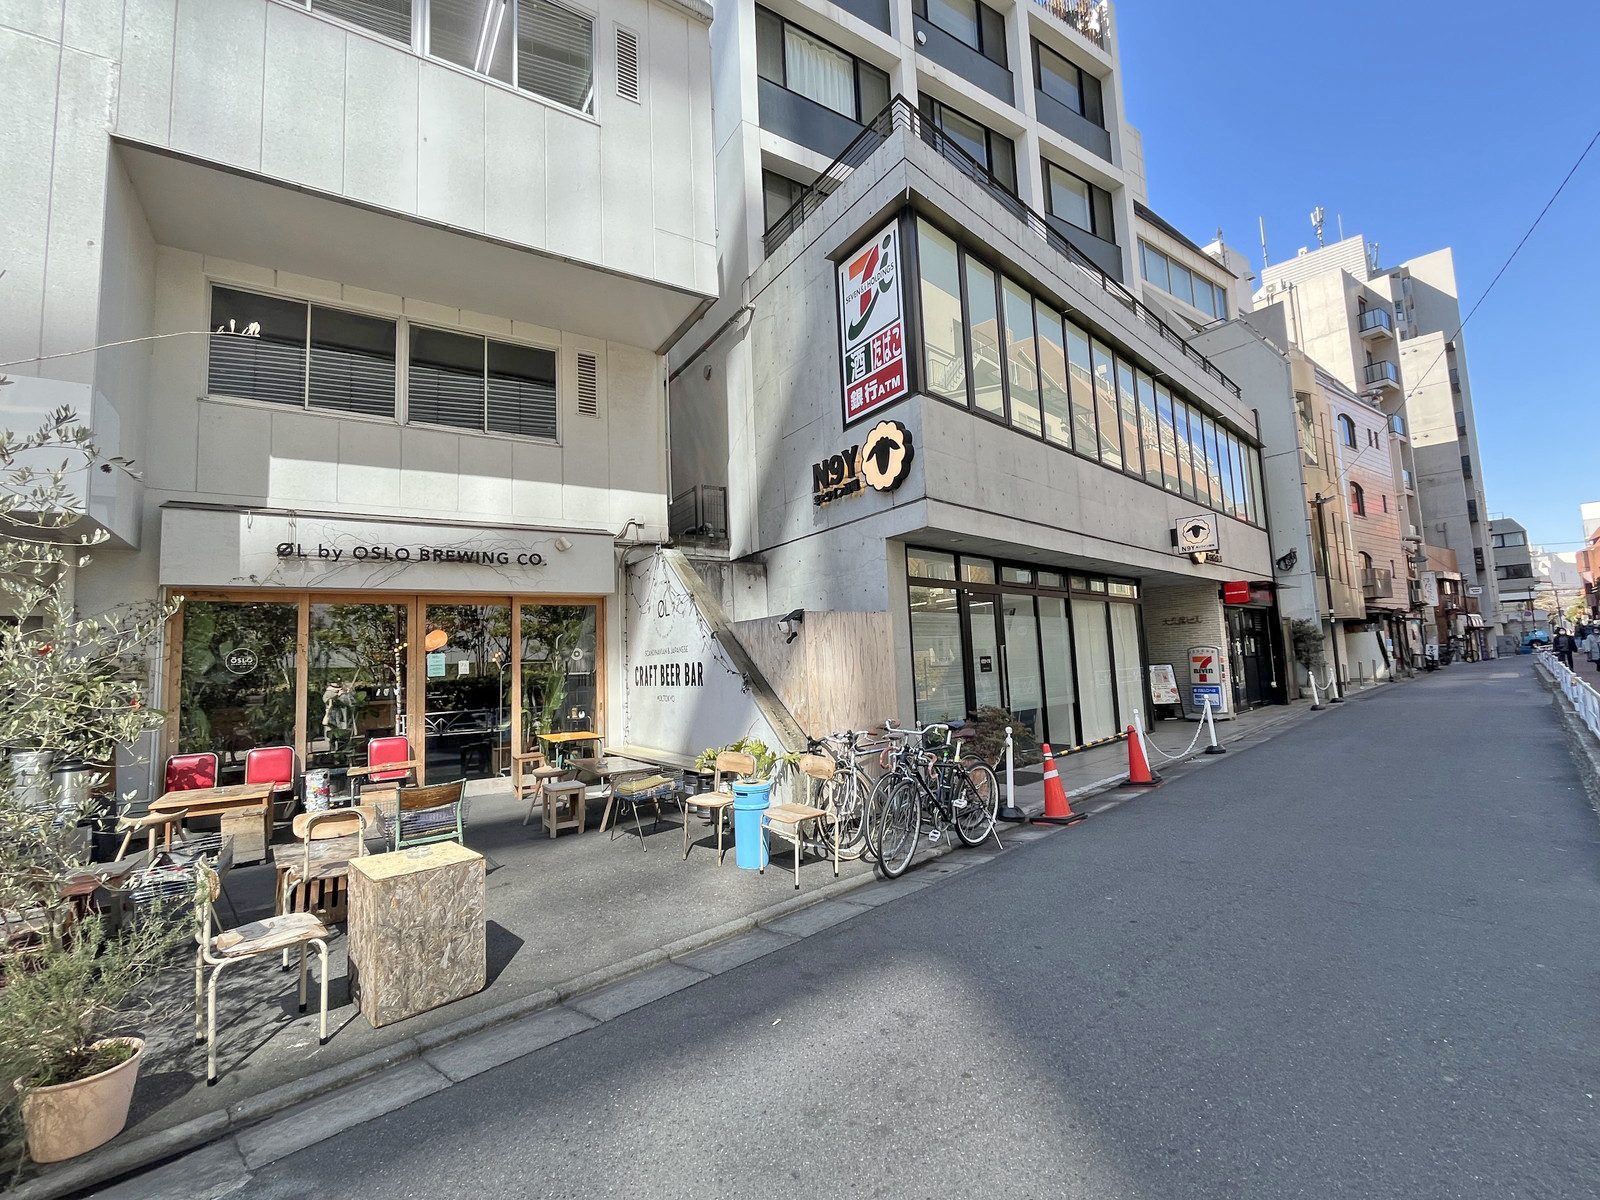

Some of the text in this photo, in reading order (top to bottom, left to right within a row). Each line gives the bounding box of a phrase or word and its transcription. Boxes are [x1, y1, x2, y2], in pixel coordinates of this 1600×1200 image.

[867, 262, 894, 288] HOLDINGS
[873, 327, 901, 369] たばこ
[851, 347, 865, 382] 酒
[812, 445, 859, 493] N9Y
[276, 542, 548, 567] ØL by OSLO BREWING CO.
[634, 661, 704, 687] CRAFT BEER BAR
